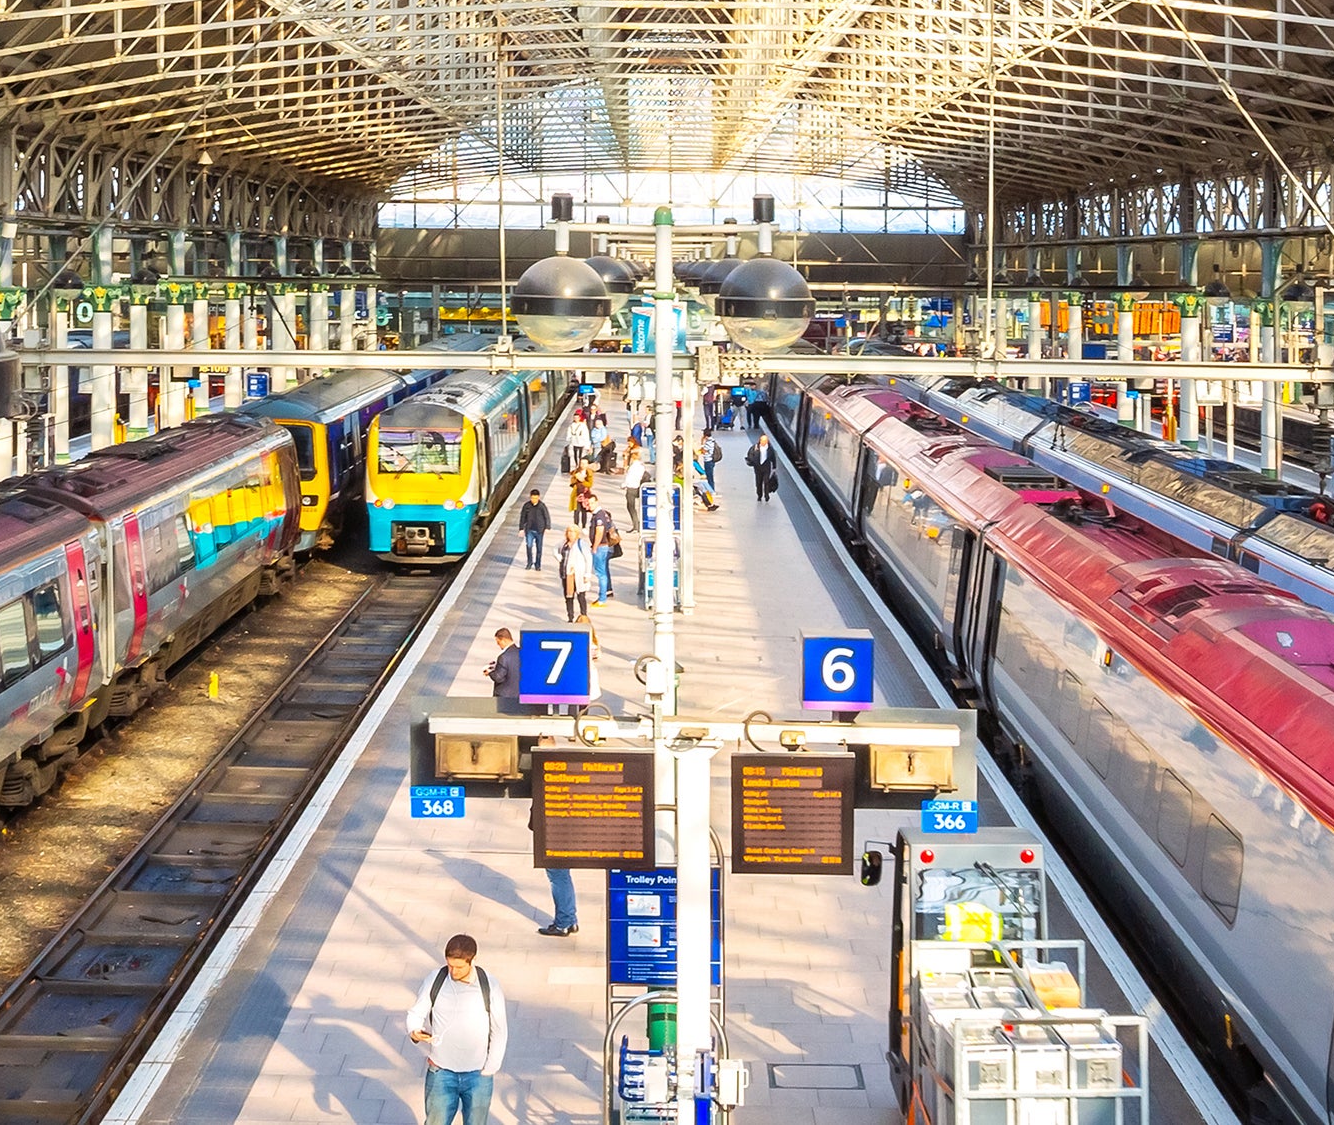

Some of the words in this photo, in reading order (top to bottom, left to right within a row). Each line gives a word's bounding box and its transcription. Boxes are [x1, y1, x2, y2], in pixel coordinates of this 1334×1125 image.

[540, 641, 572, 684] 7
[822, 647, 856, 692] 6
[743, 778, 771, 787] London
[772, 778, 800, 787] Euston
[422, 800, 454, 815] 368
[933, 814, 966, 830] 366
[626, 875, 656, 886] Trolley
[657, 875, 677, 884] Poin
